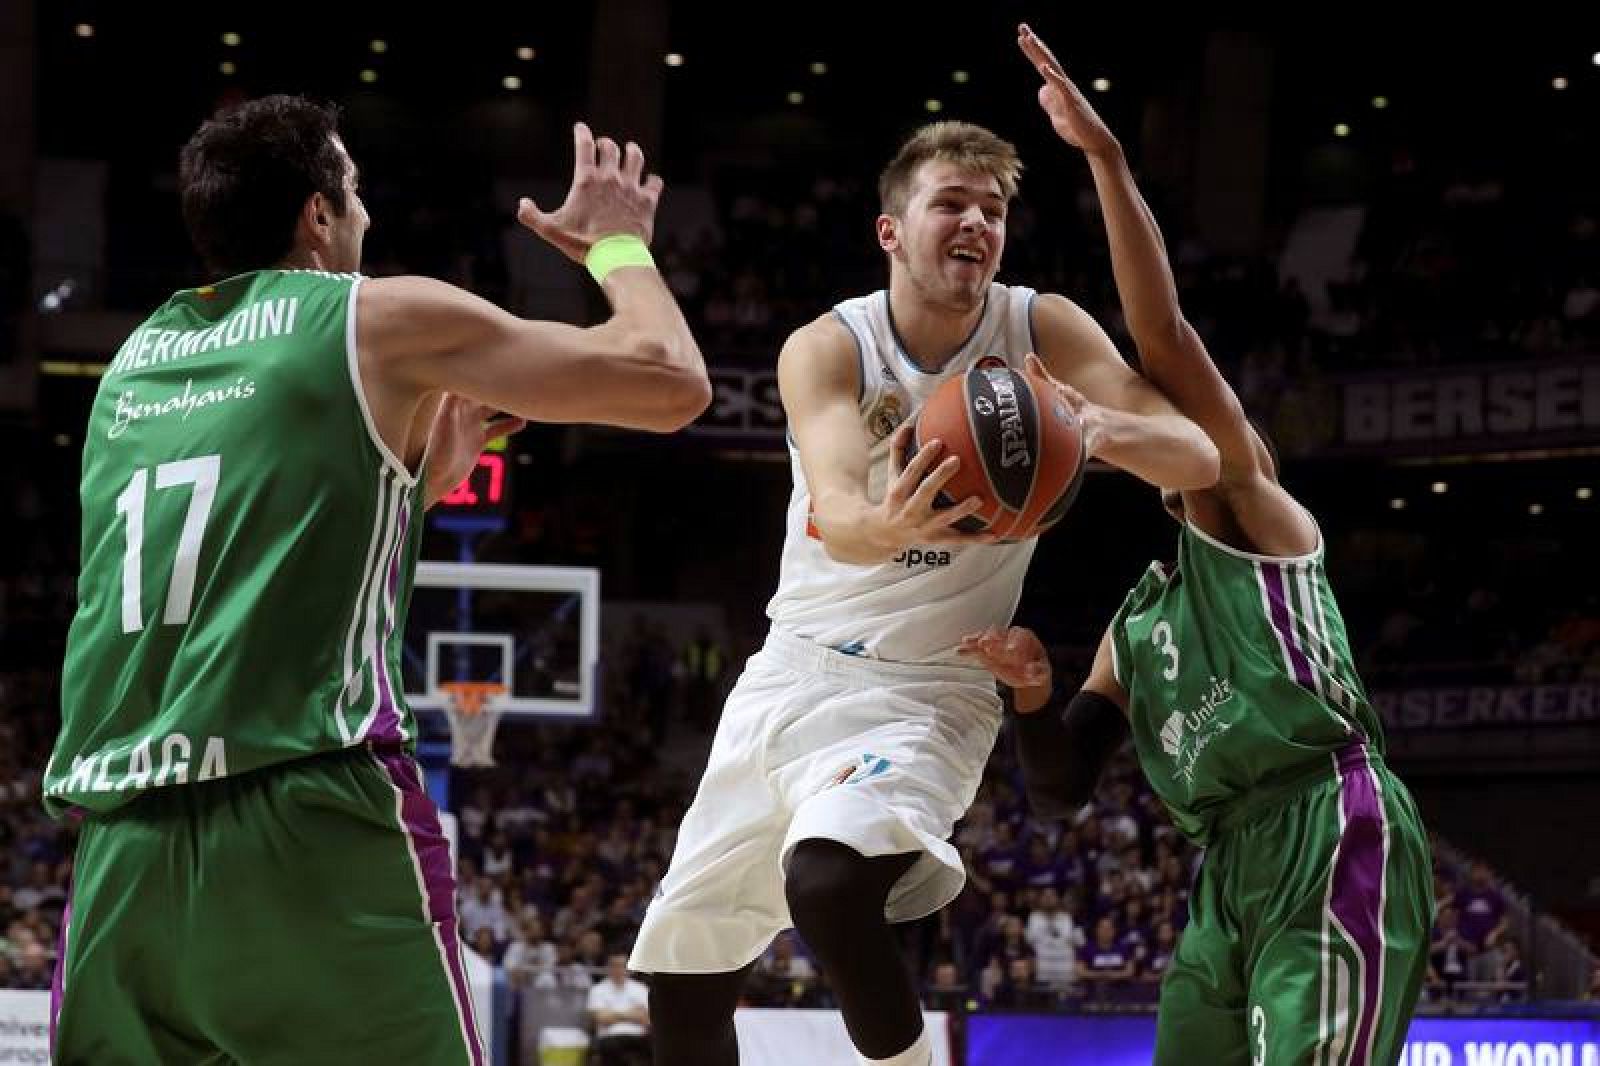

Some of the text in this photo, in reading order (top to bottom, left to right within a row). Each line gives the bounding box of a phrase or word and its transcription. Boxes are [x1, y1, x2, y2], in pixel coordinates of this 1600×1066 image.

[110, 297, 299, 374] HERMADINI
[983, 368, 1030, 469] SPALD
[115, 454, 221, 634] 17
[1152, 621, 1179, 681] 3
